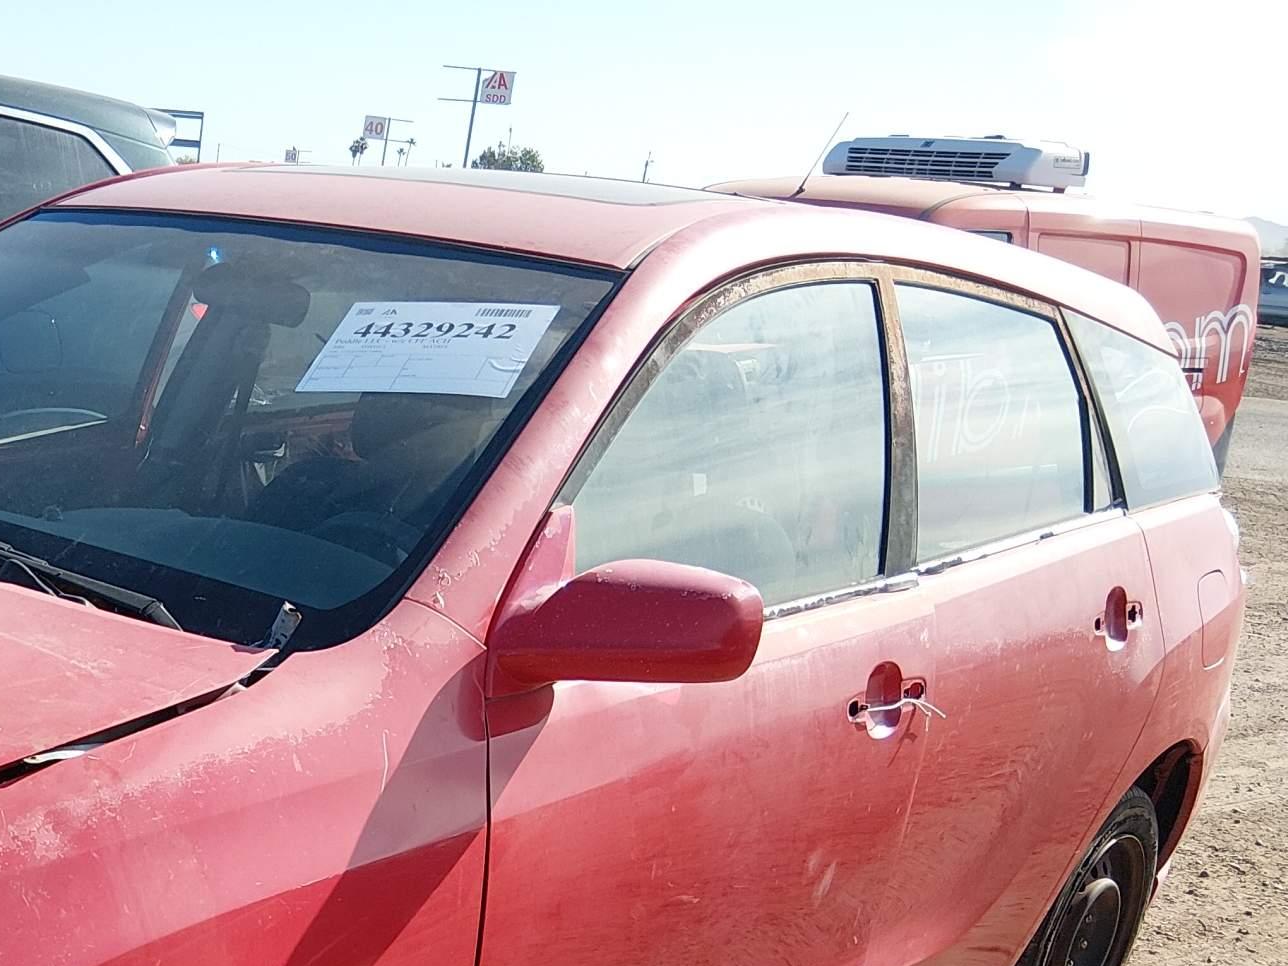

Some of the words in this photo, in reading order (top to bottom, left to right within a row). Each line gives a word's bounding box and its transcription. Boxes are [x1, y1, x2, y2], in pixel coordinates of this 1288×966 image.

[484, 93, 507, 104] SDD
[364, 120, 384, 136] 40
[352, 322, 517, 340] 44329242
